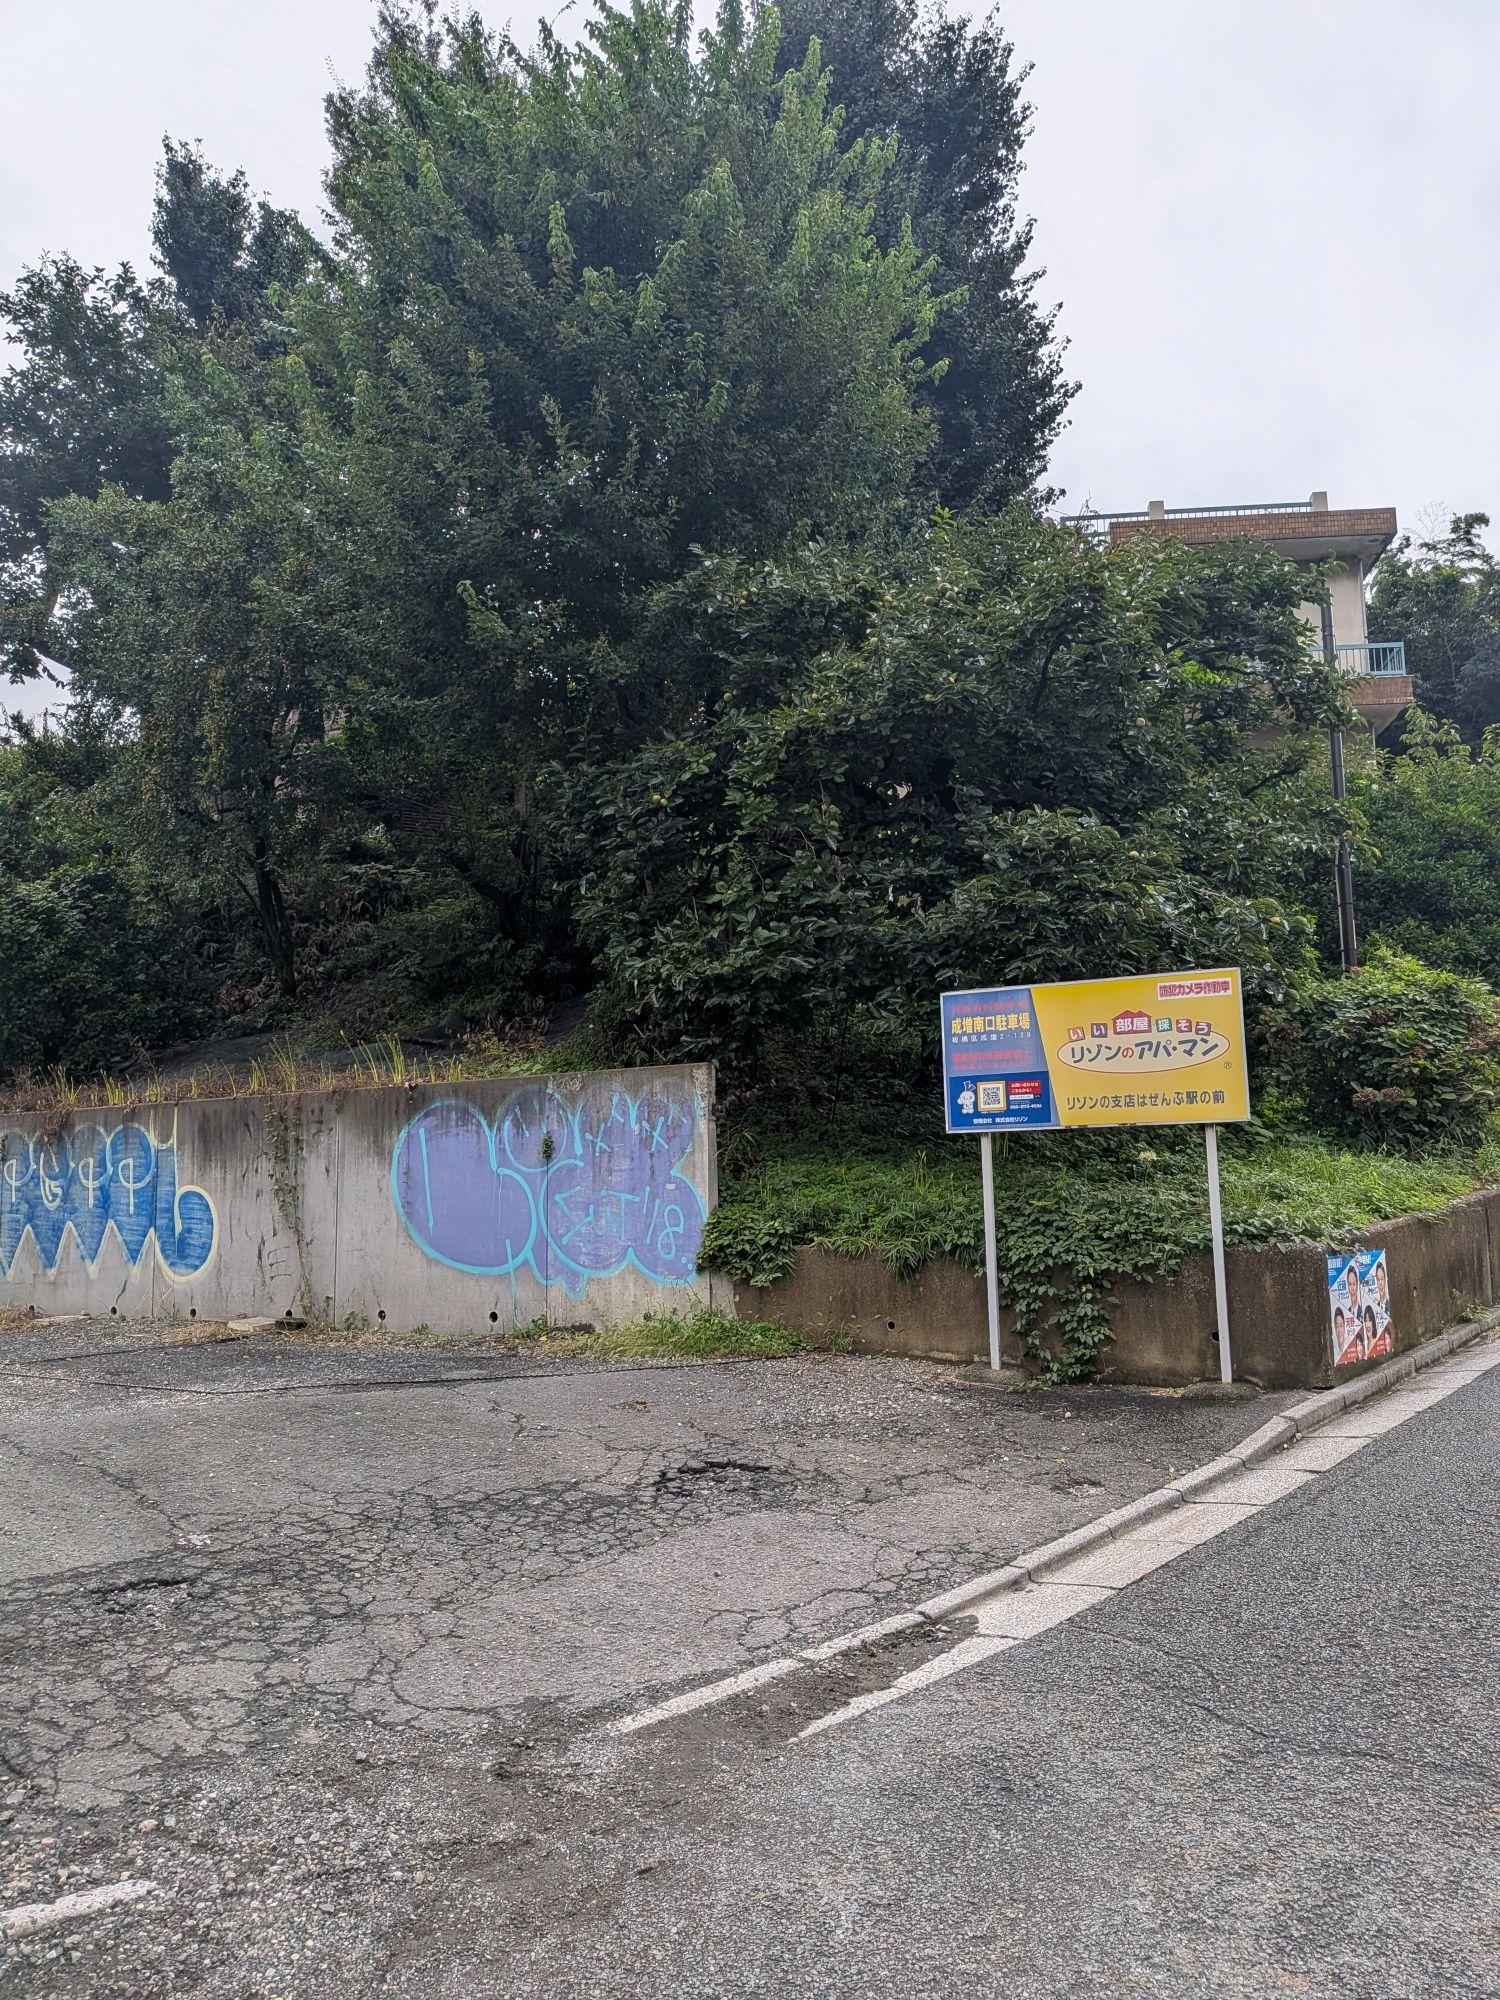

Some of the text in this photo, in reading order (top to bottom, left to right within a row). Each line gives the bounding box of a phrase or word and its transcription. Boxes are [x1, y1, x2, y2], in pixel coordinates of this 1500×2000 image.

[1159, 980, 1230, 997] 防犯カメラ作動中
[952, 1013, 1030, 1034] 成増南口駐車場
[1069, 1017, 1210, 1040] いい部屋探そう
[1067, 1090, 1225, 1110] リゾンの支店はぜんぶ駅の前
